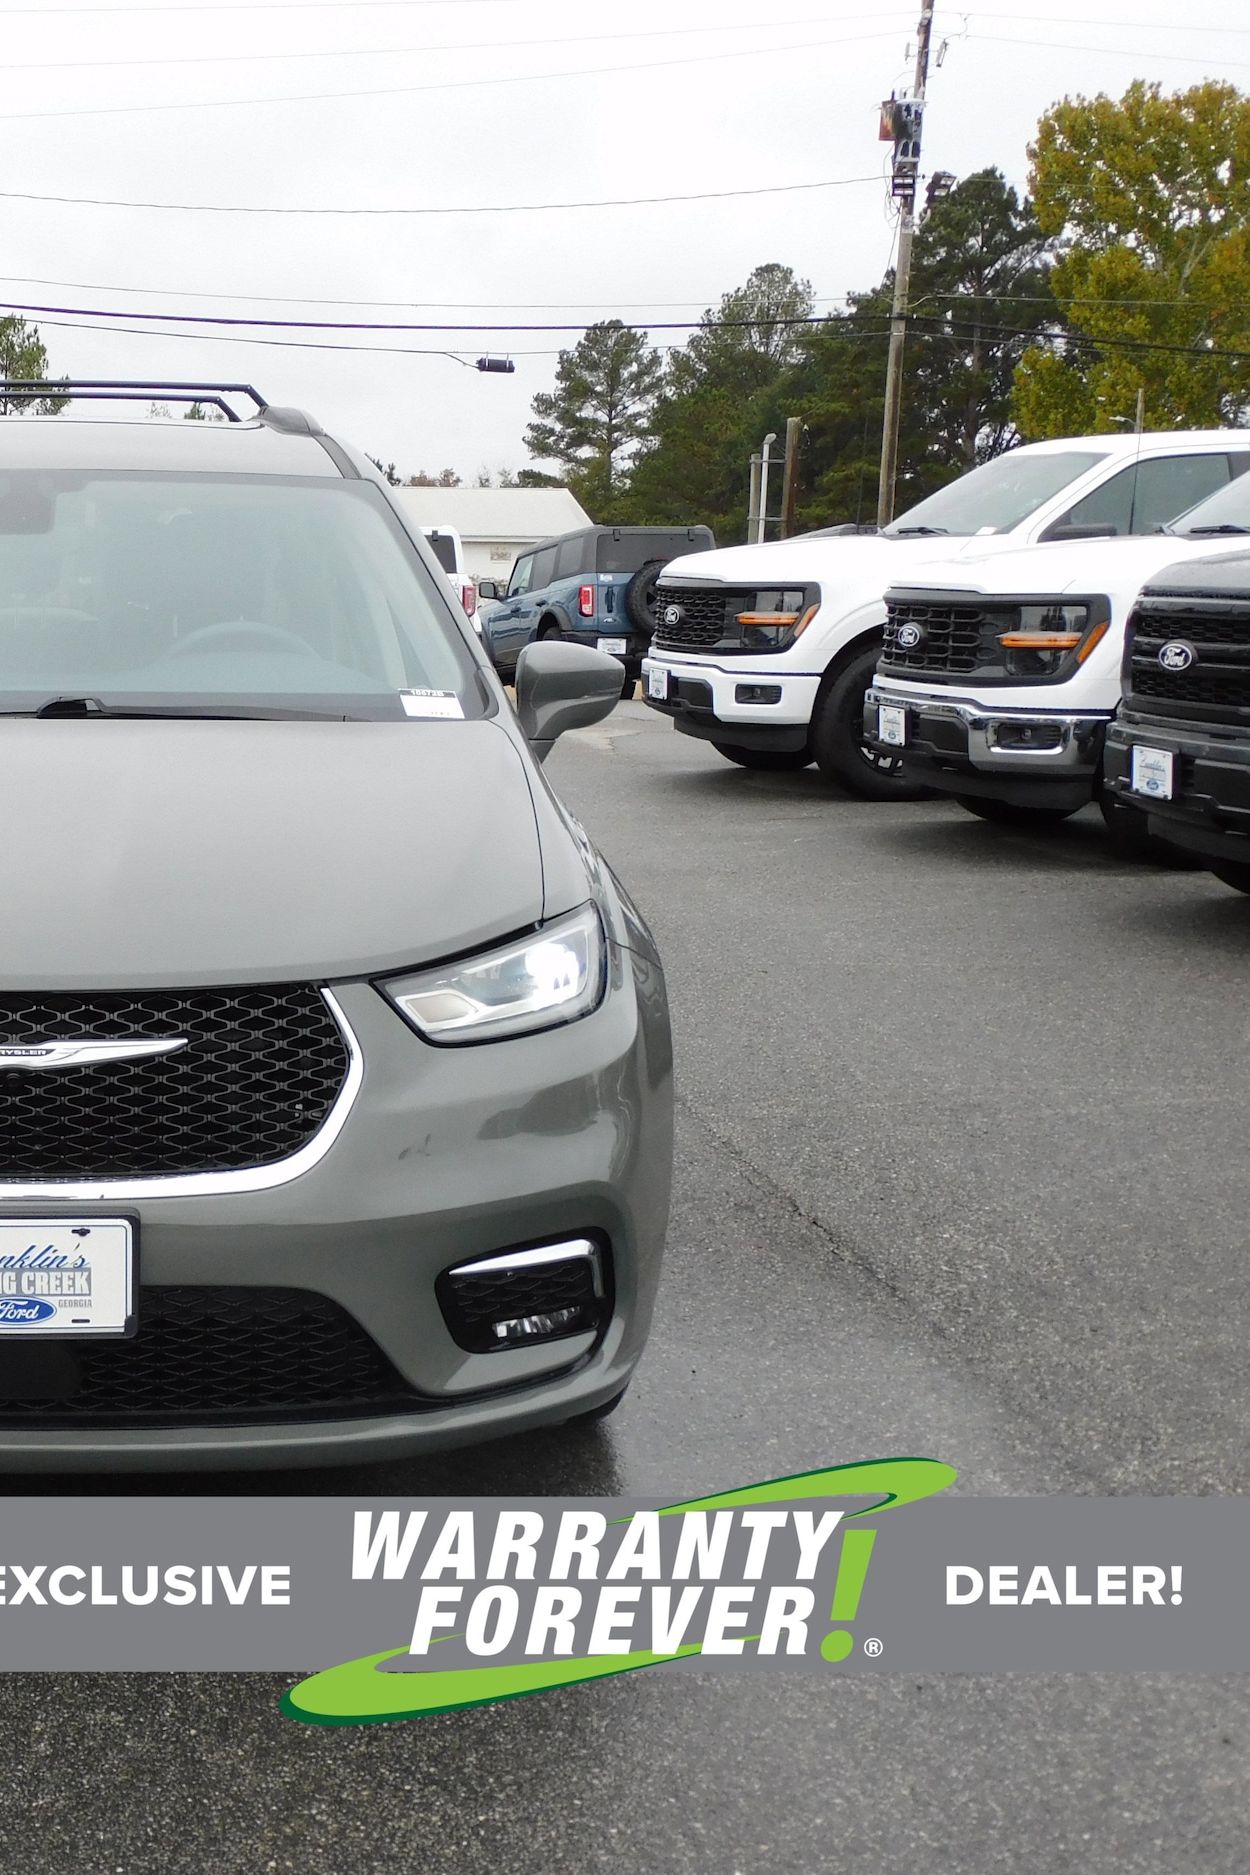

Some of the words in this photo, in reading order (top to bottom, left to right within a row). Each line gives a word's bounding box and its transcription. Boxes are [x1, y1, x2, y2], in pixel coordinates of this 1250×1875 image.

[1164, 646, 1186, 666] Ford
[21, 1271, 90, 1295] CREEK
[58, 1299, 92, 1309] GEORGIA
